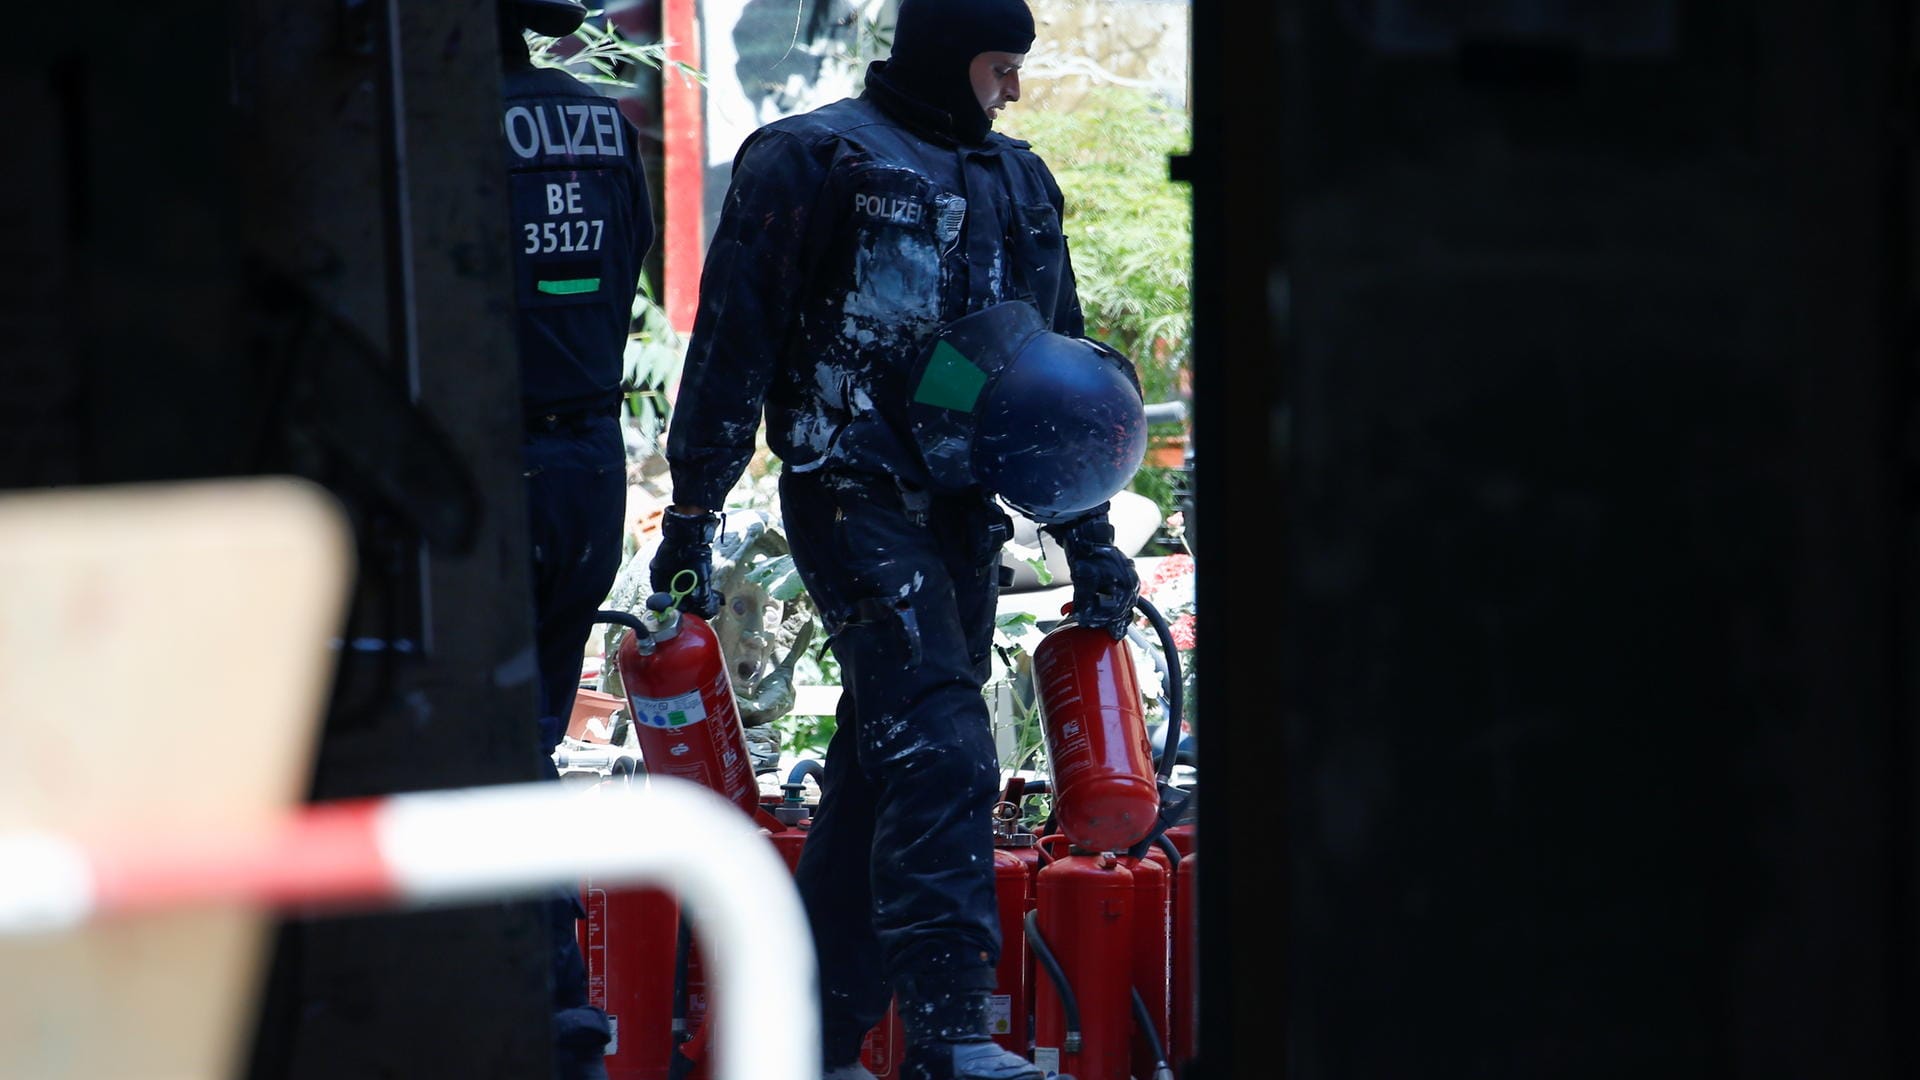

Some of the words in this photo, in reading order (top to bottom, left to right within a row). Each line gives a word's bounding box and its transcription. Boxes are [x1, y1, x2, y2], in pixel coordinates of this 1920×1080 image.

[504, 104, 624, 159] OLIZEI
[546, 182, 583, 215] BE
[855, 193, 922, 225] POLIZEI
[524, 219, 604, 255] 35127
